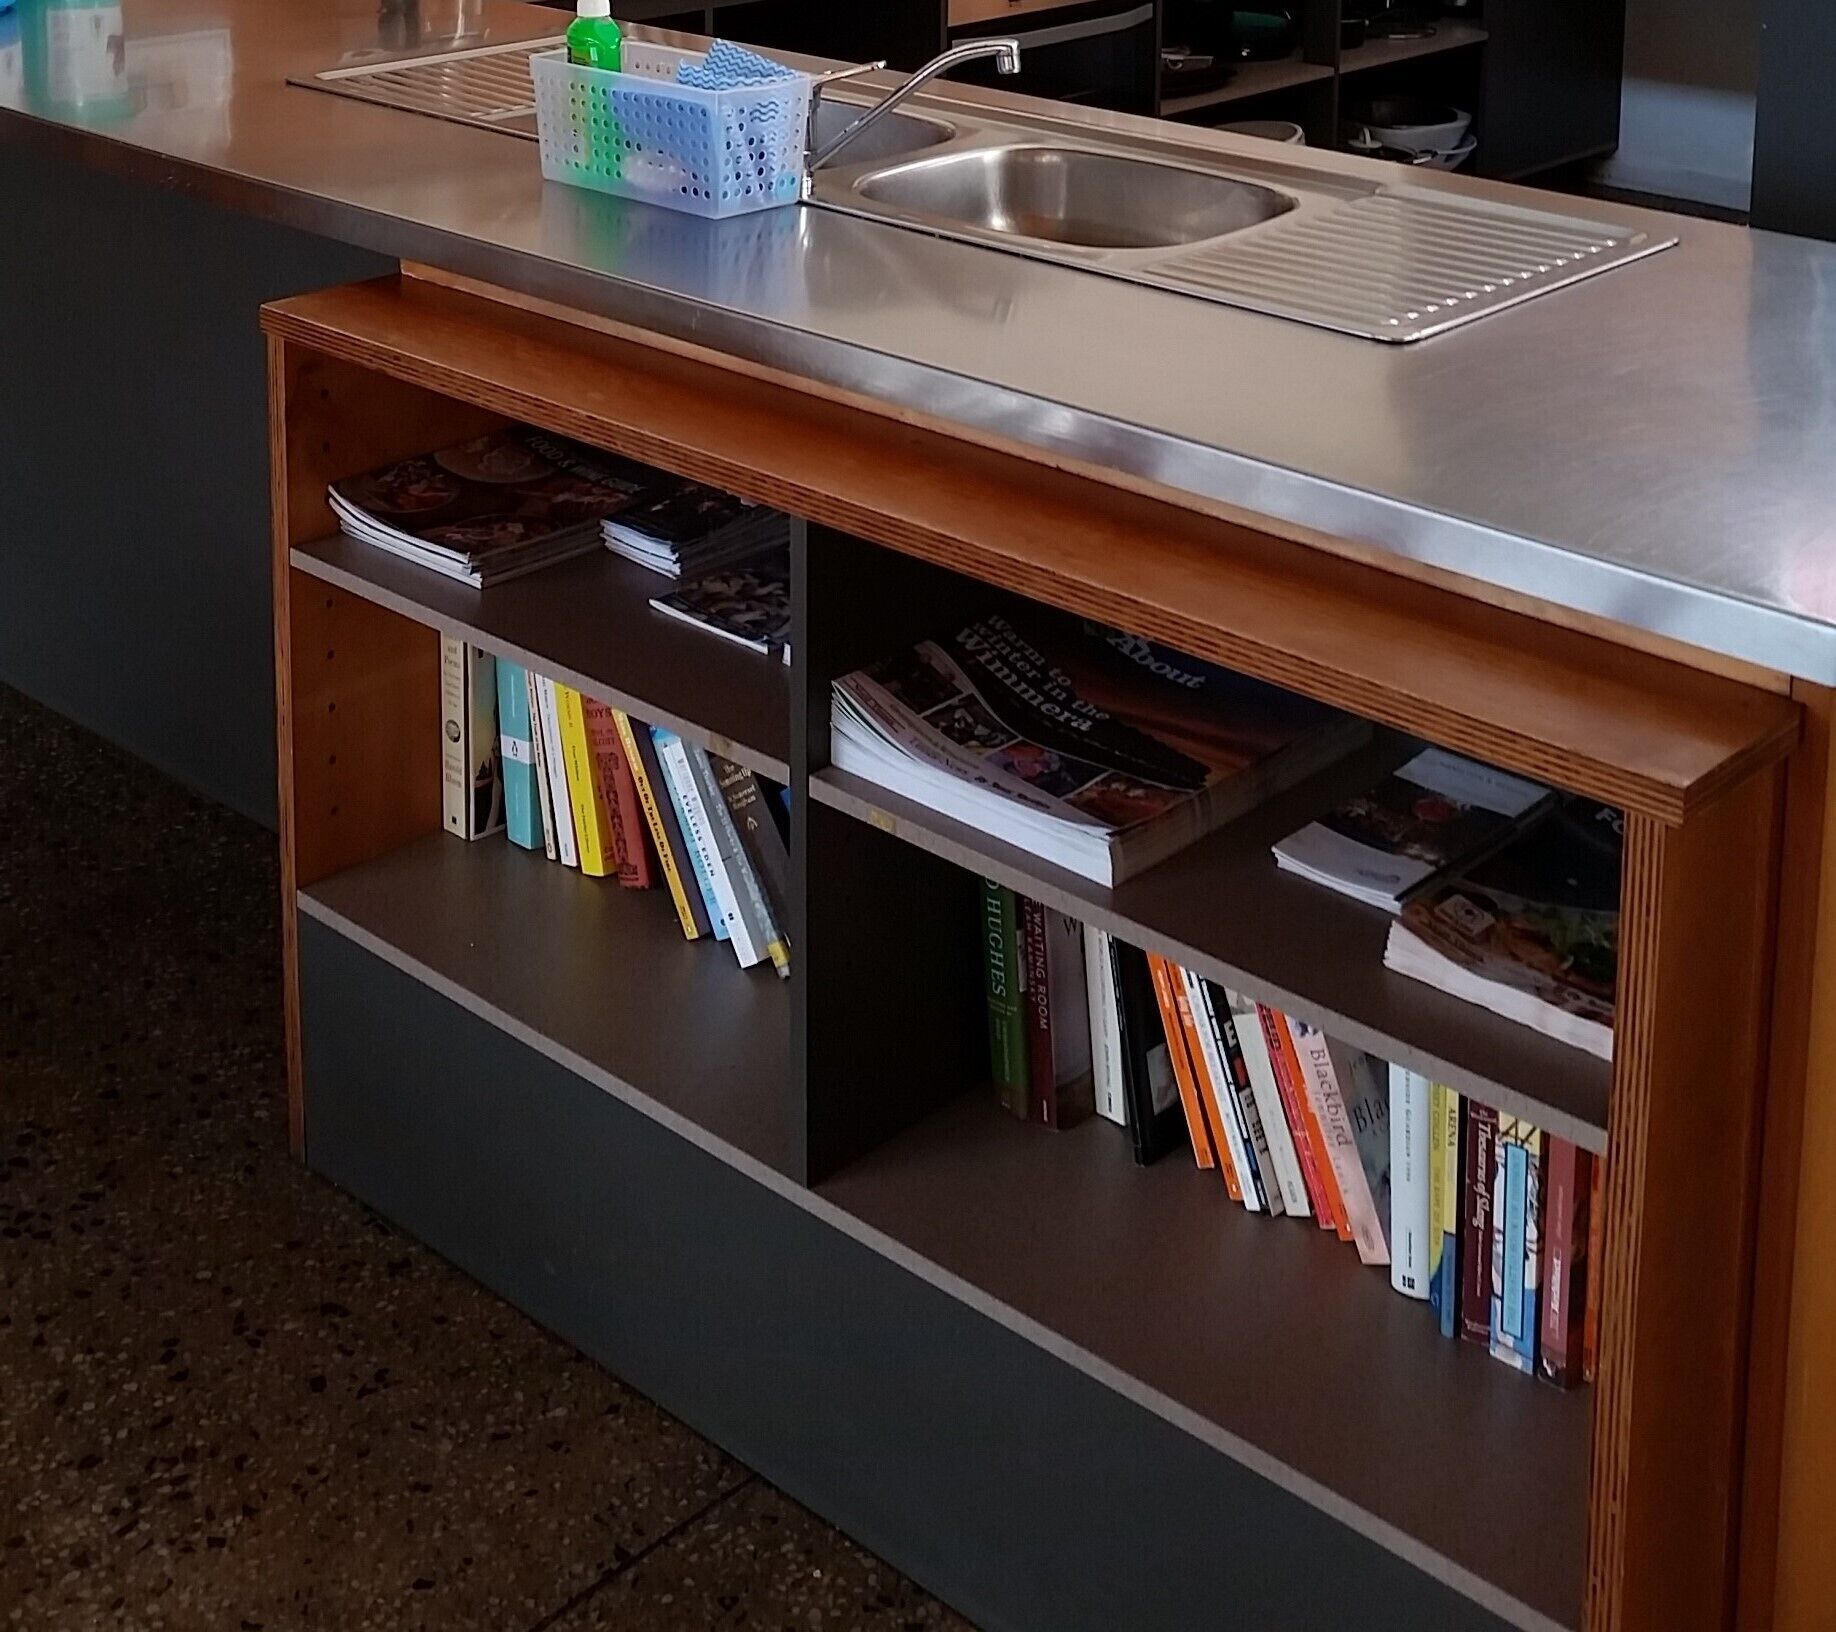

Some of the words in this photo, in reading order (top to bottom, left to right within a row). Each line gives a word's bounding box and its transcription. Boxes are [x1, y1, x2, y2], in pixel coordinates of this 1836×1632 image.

[956, 627, 1093, 732] Wimmera
[1106, 633, 1208, 688] About
[1043, 679, 1067, 701] in
[1072, 700, 1110, 720] the
[701, 846, 716, 877] EDEN
[986, 897, 1007, 998] HUGHES
[1032, 912, 1046, 979] WAITING
[1036, 986, 1049, 1030] ROOM
[1310, 1048, 1353, 1148] Blackbird
[1448, 1108, 1456, 1147] ARENA
